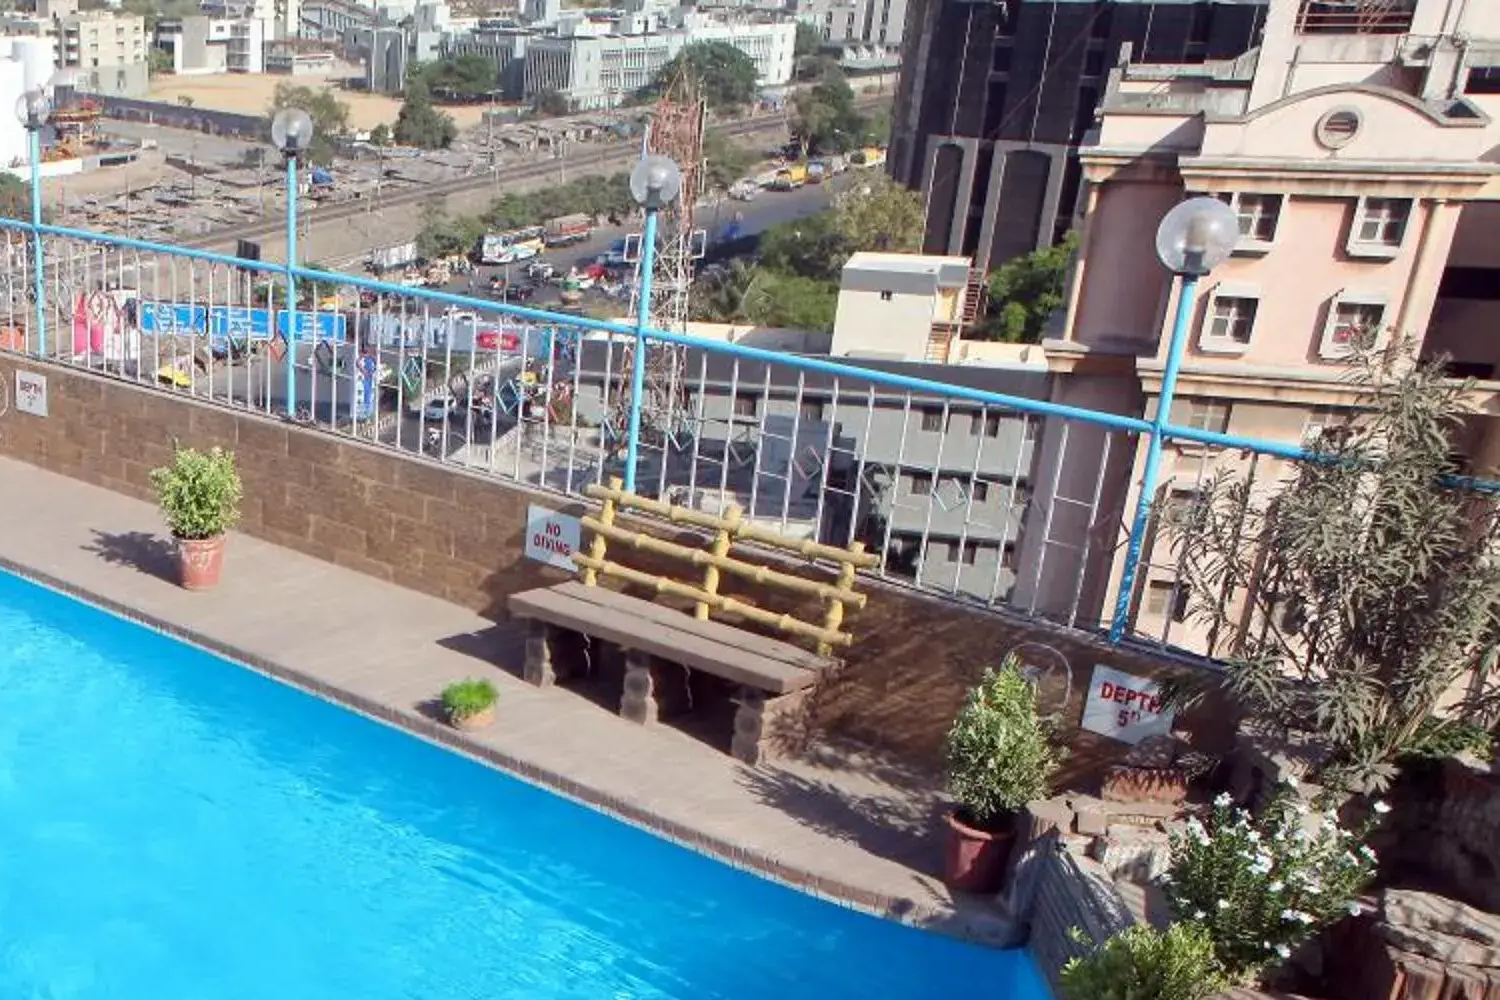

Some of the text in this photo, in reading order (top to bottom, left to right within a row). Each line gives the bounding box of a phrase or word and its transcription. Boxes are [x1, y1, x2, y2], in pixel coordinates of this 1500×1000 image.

[546, 521, 561, 537] NO
[533, 533, 571, 556] DIVING
[1101, 681, 1164, 714] DEPTH
